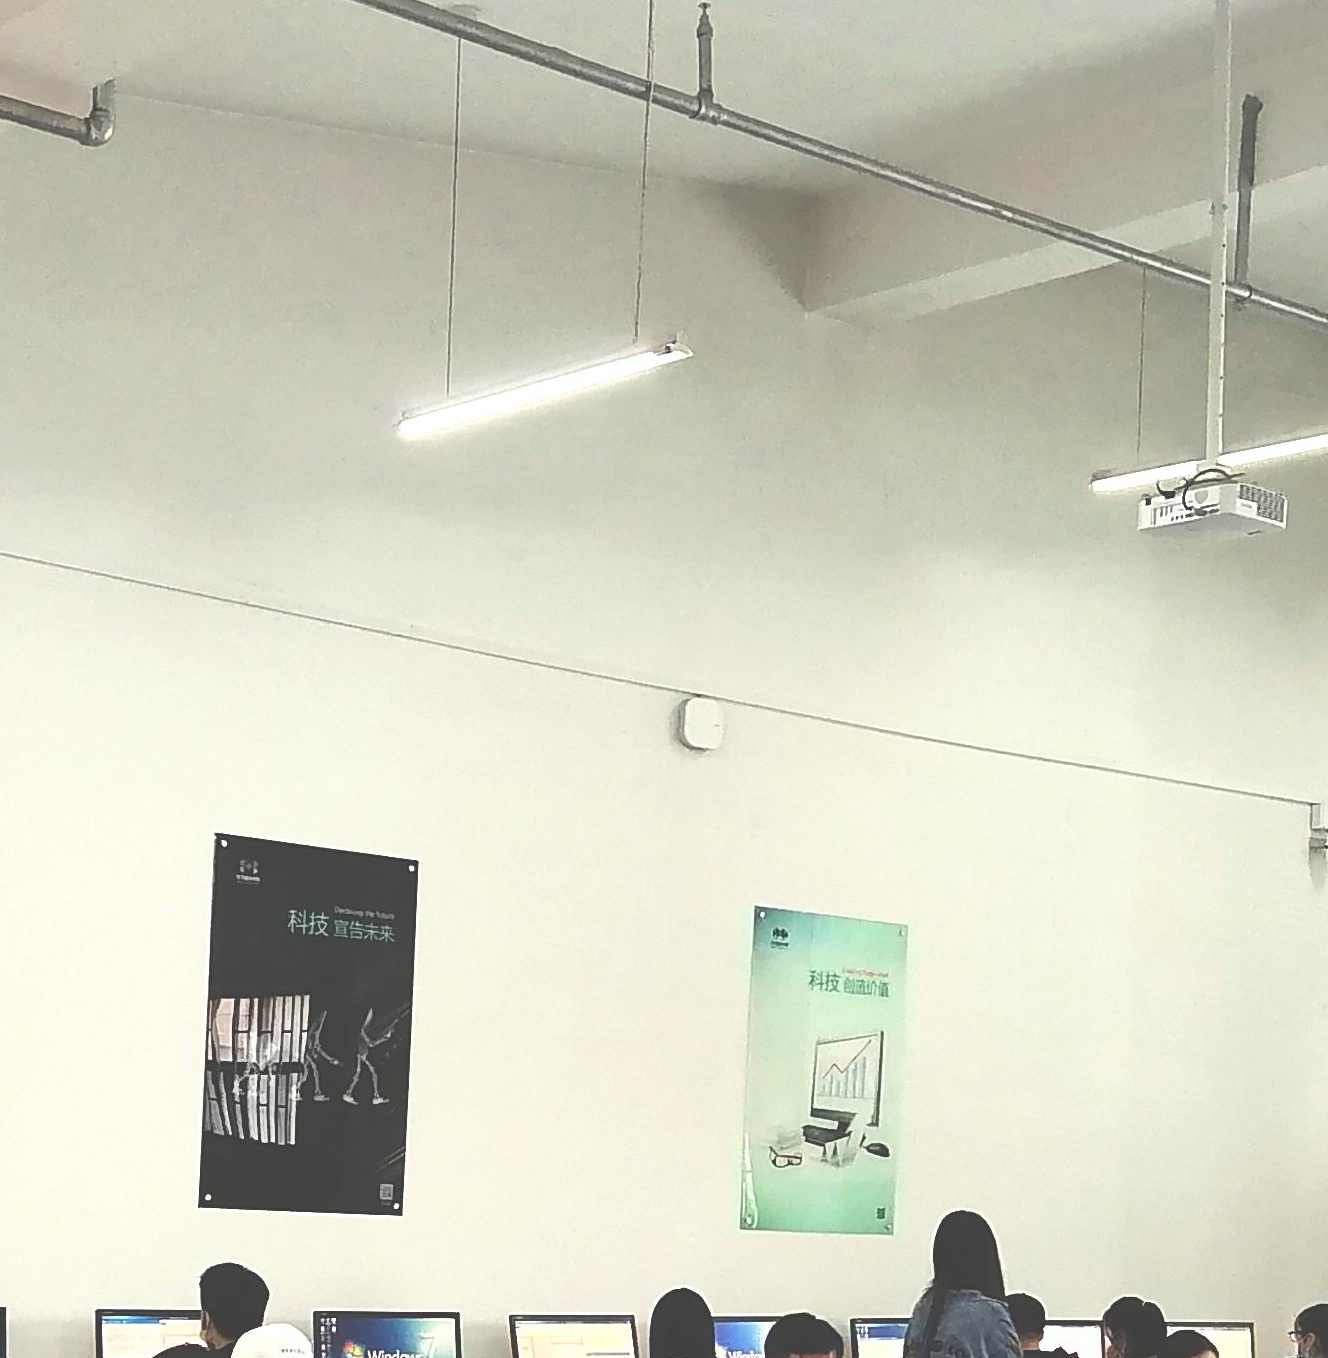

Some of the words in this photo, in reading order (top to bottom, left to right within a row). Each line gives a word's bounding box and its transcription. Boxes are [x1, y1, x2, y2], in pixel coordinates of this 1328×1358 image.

[287, 909, 330, 937] 科技
[334, 919, 395, 943] 宣告未来
[808, 969, 841, 993] 科技
